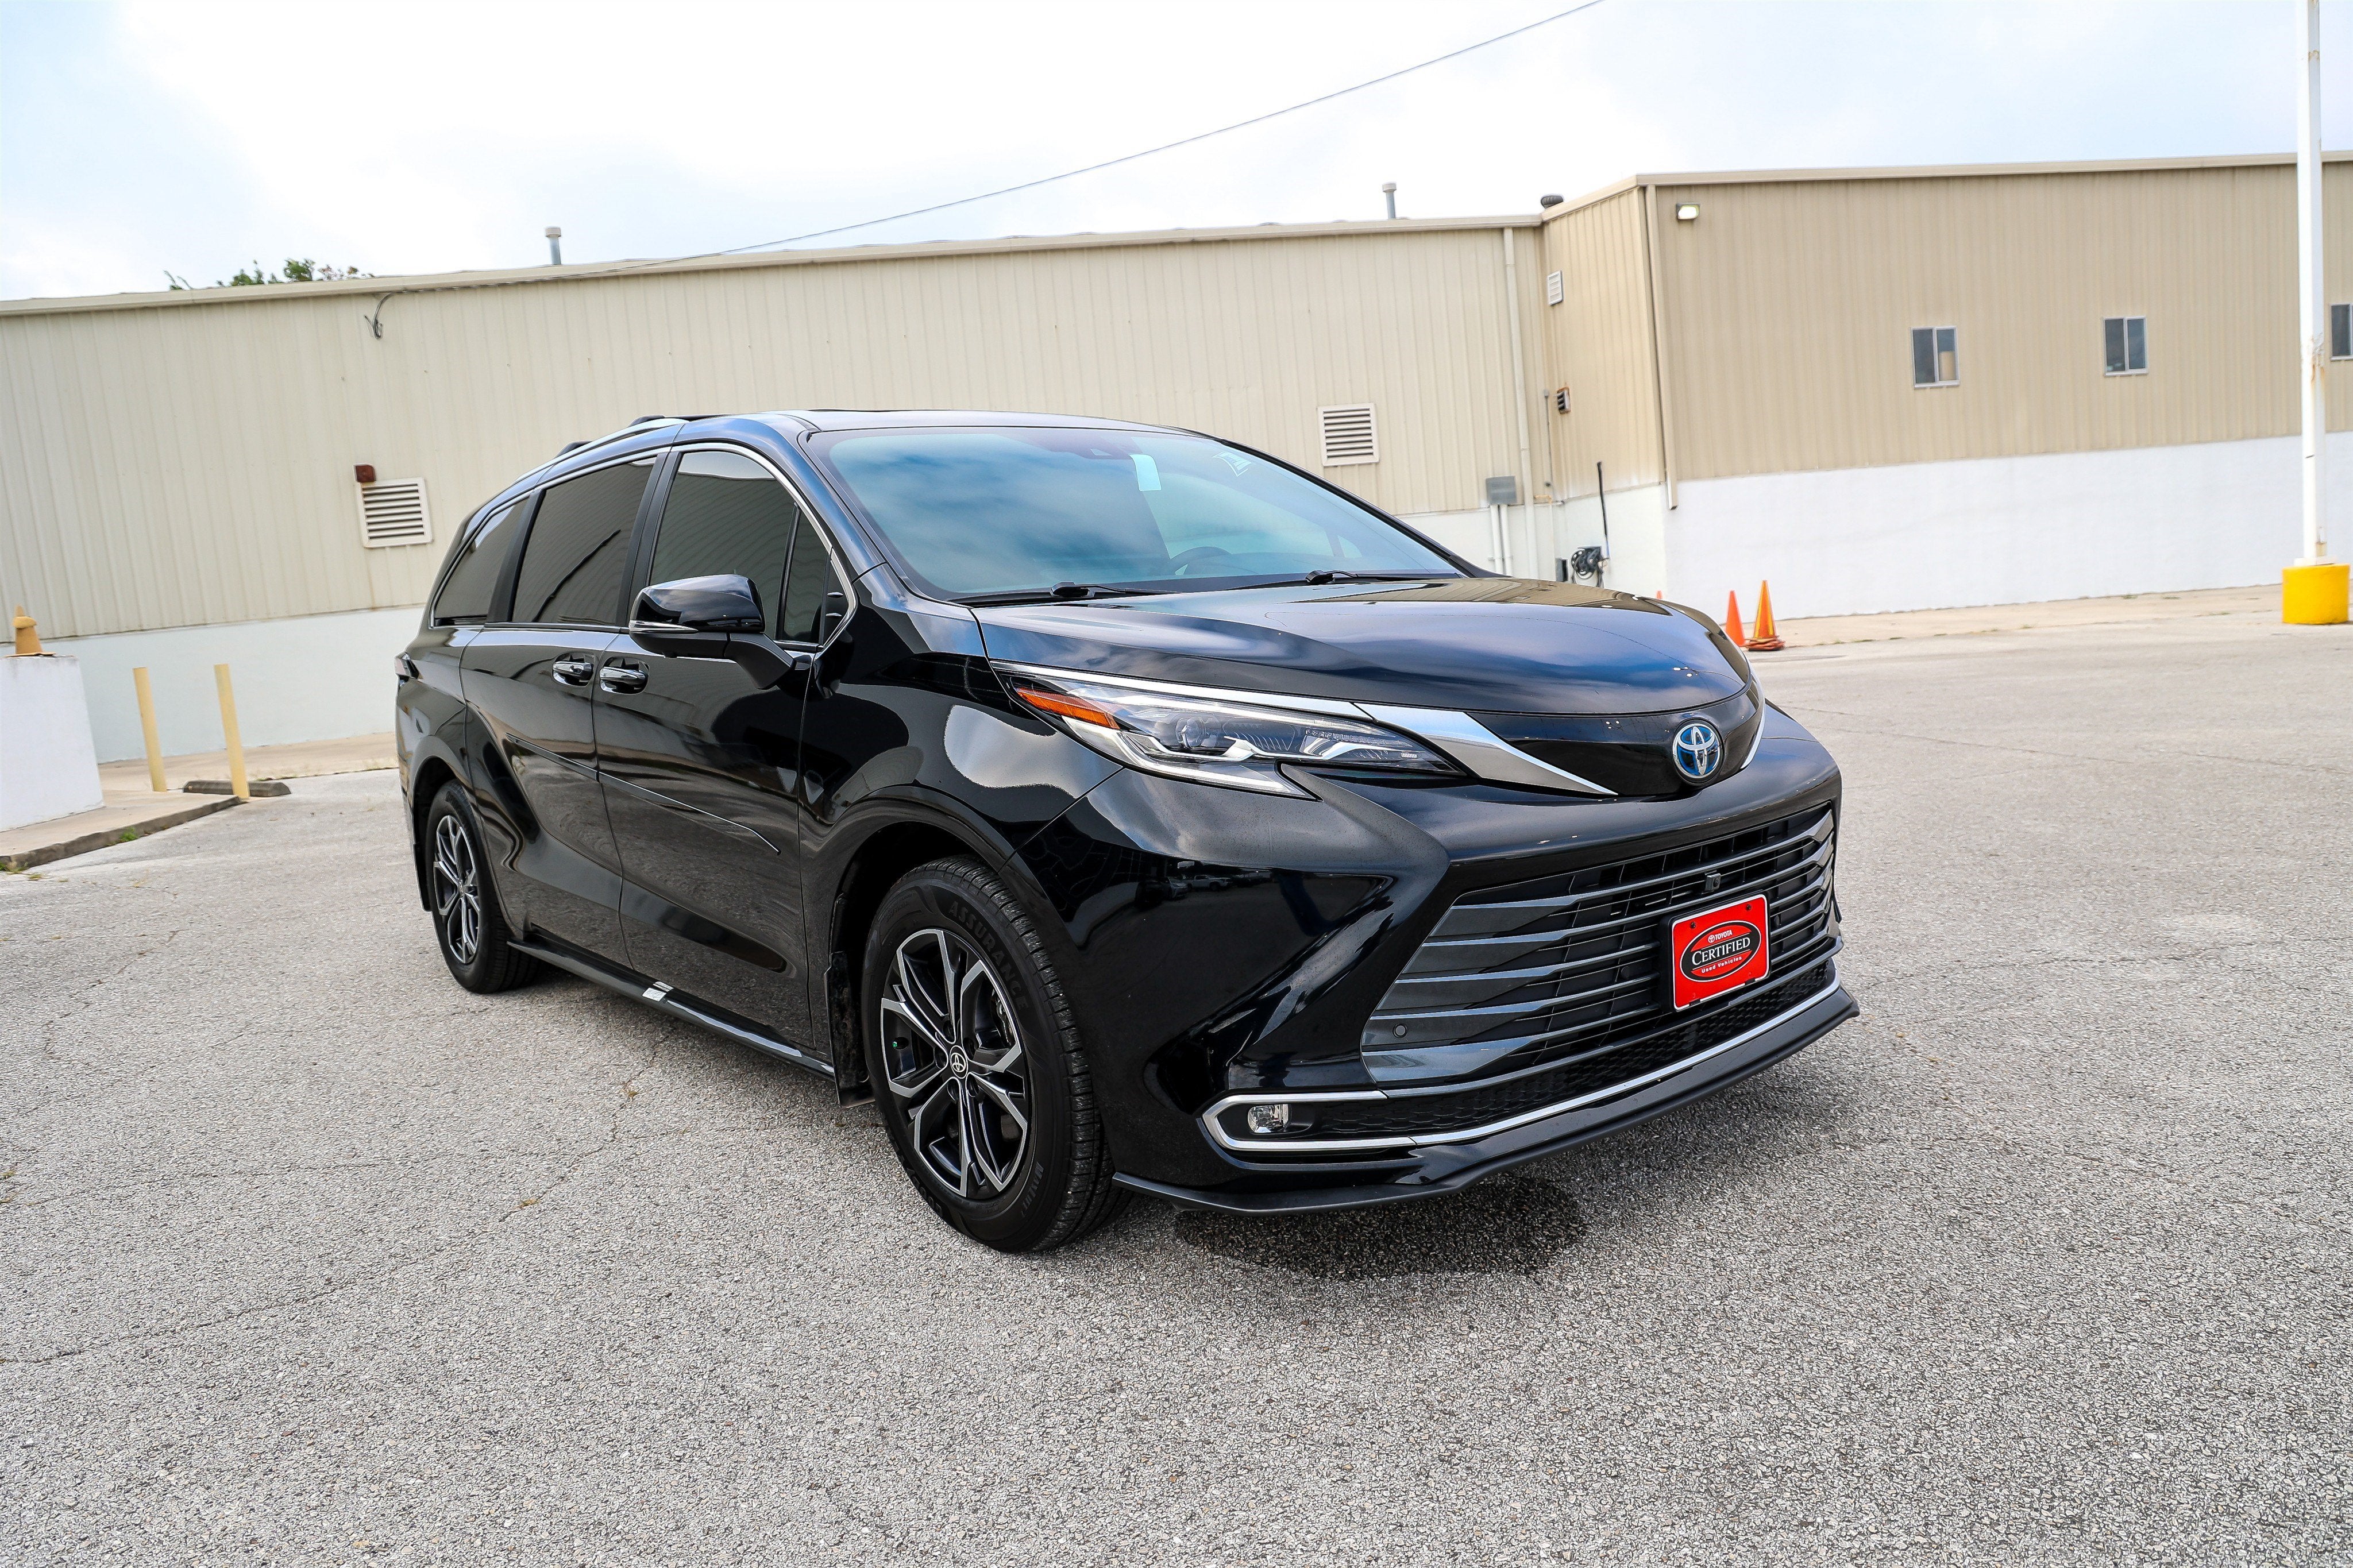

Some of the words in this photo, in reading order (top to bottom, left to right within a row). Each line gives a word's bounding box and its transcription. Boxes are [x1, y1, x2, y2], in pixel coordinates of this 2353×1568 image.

[1715, 929, 1732, 941] TOYOTA
[949, 901, 1029, 1010] ASSURANCE
[1692, 937, 1750, 965] CERTIFIED
[1702, 965, 1716, 974] Used
[1718, 956, 1742, 968] Vehicles
